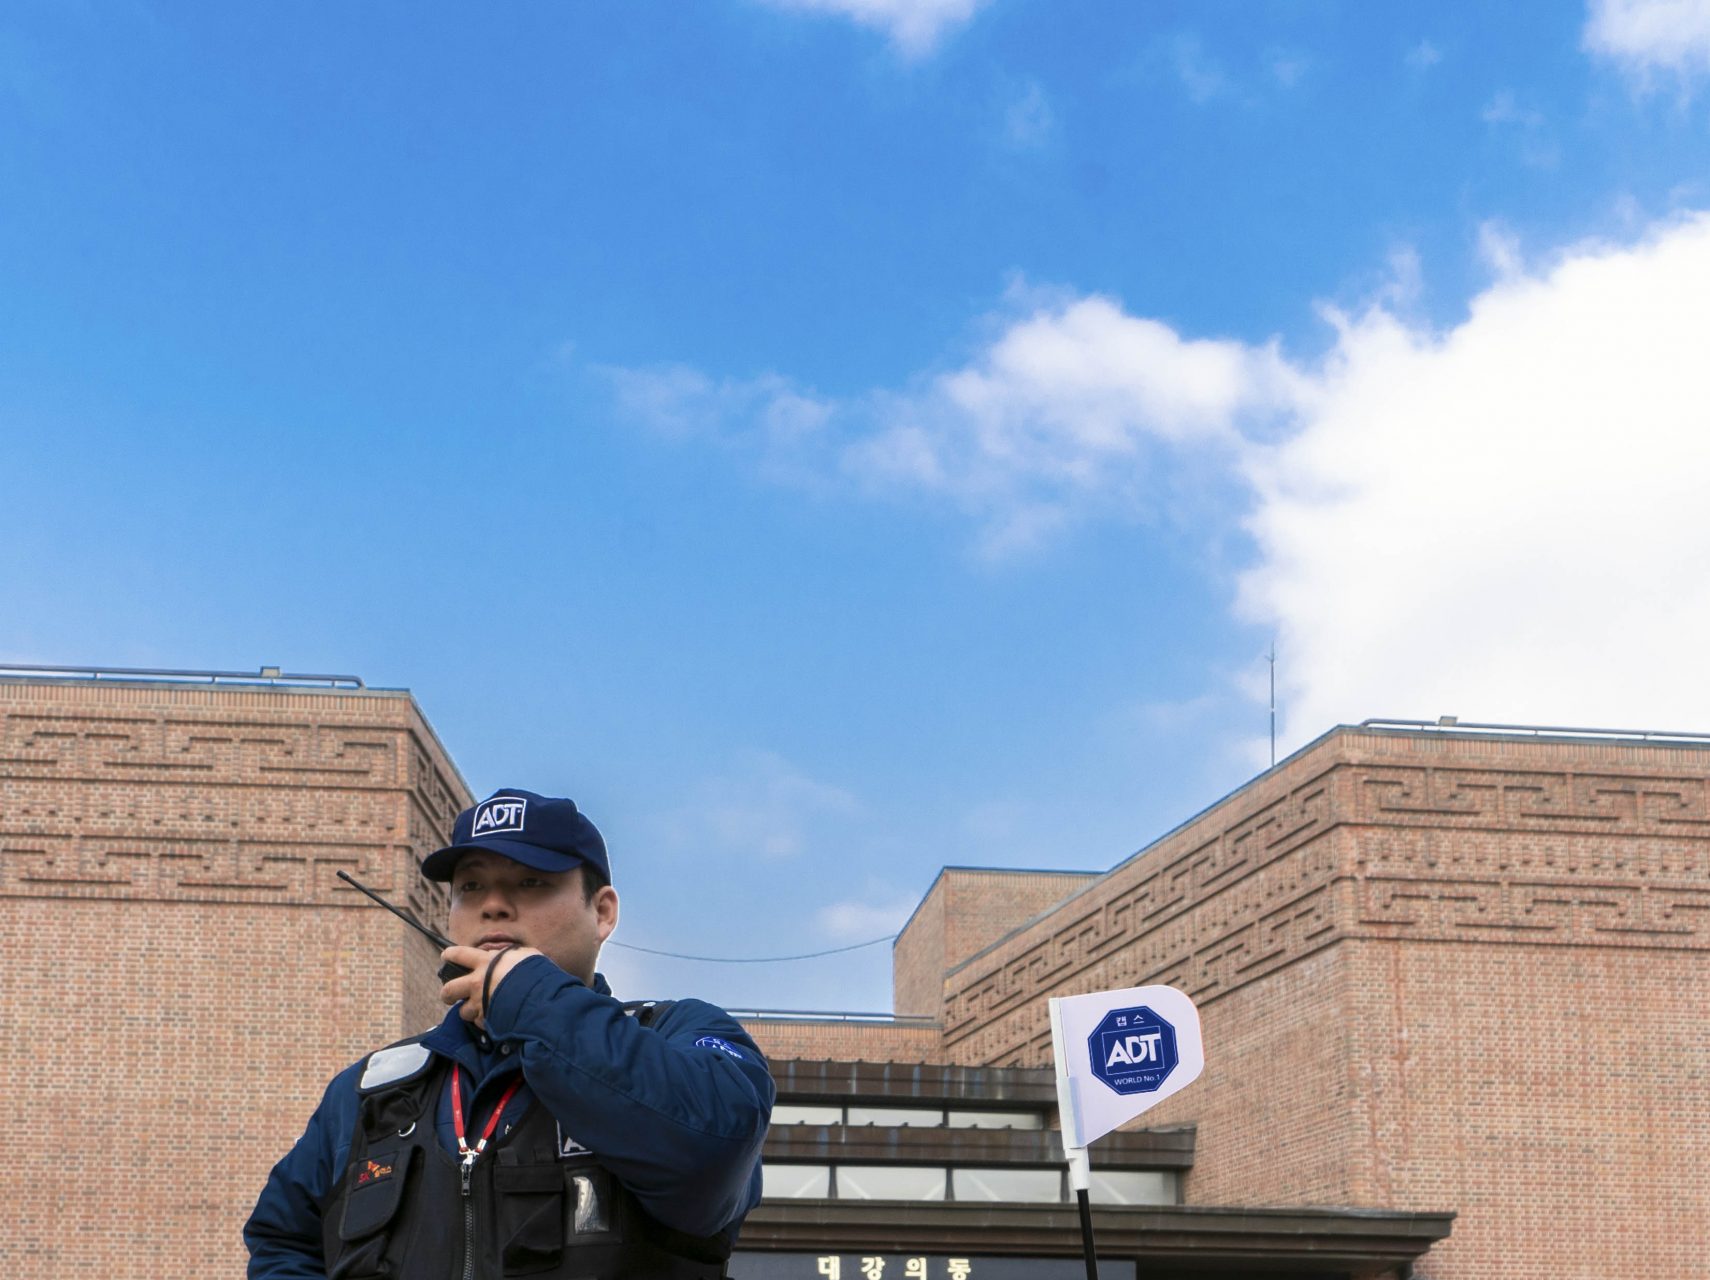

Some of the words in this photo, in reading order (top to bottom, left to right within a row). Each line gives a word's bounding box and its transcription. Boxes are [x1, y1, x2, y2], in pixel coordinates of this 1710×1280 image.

[476, 803, 523, 830] ADT
[1106, 1033, 1162, 1067] ADT
[1114, 1076, 1143, 1086] WORLD
